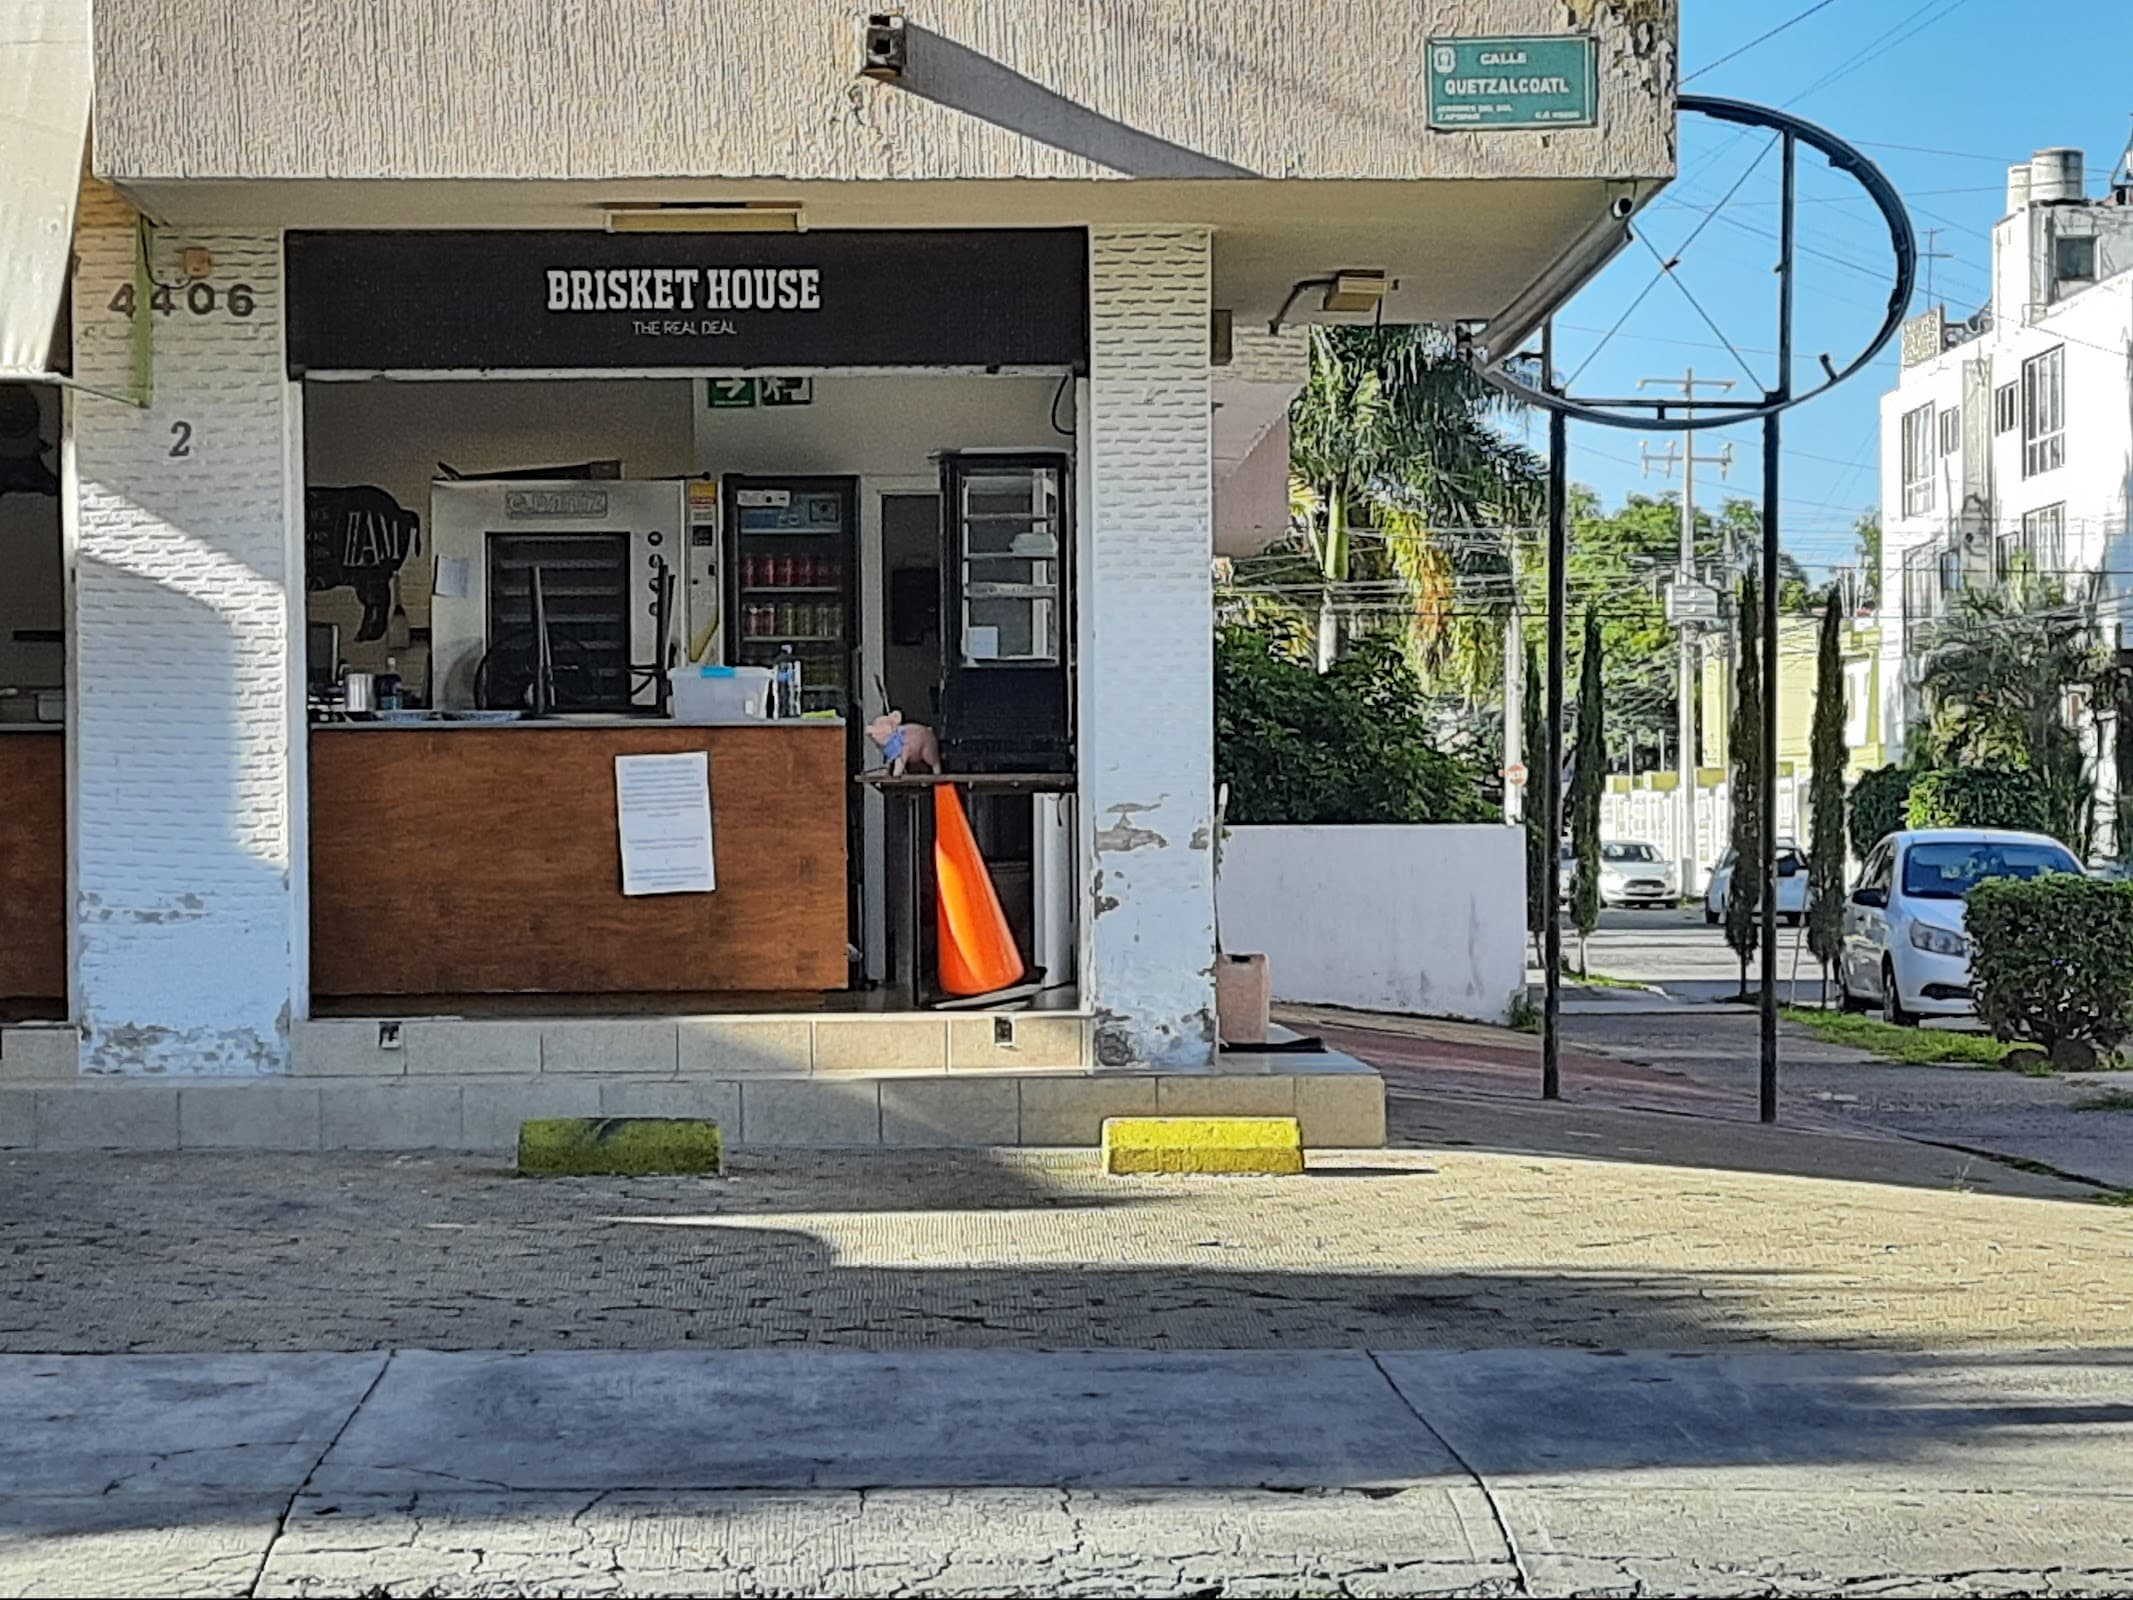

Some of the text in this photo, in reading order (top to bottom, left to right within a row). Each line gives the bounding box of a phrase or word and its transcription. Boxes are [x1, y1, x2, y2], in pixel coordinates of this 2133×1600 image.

[1480, 52, 1527, 65] CALLE
[1445, 77, 1569, 95] QUETZALCOATL
[109, 282, 254, 318] 4406
[547, 269, 821, 310] BRISKET HOUSE
[632, 320, 737, 335] THE REAL DEAL
[168, 420, 192, 457] 2
